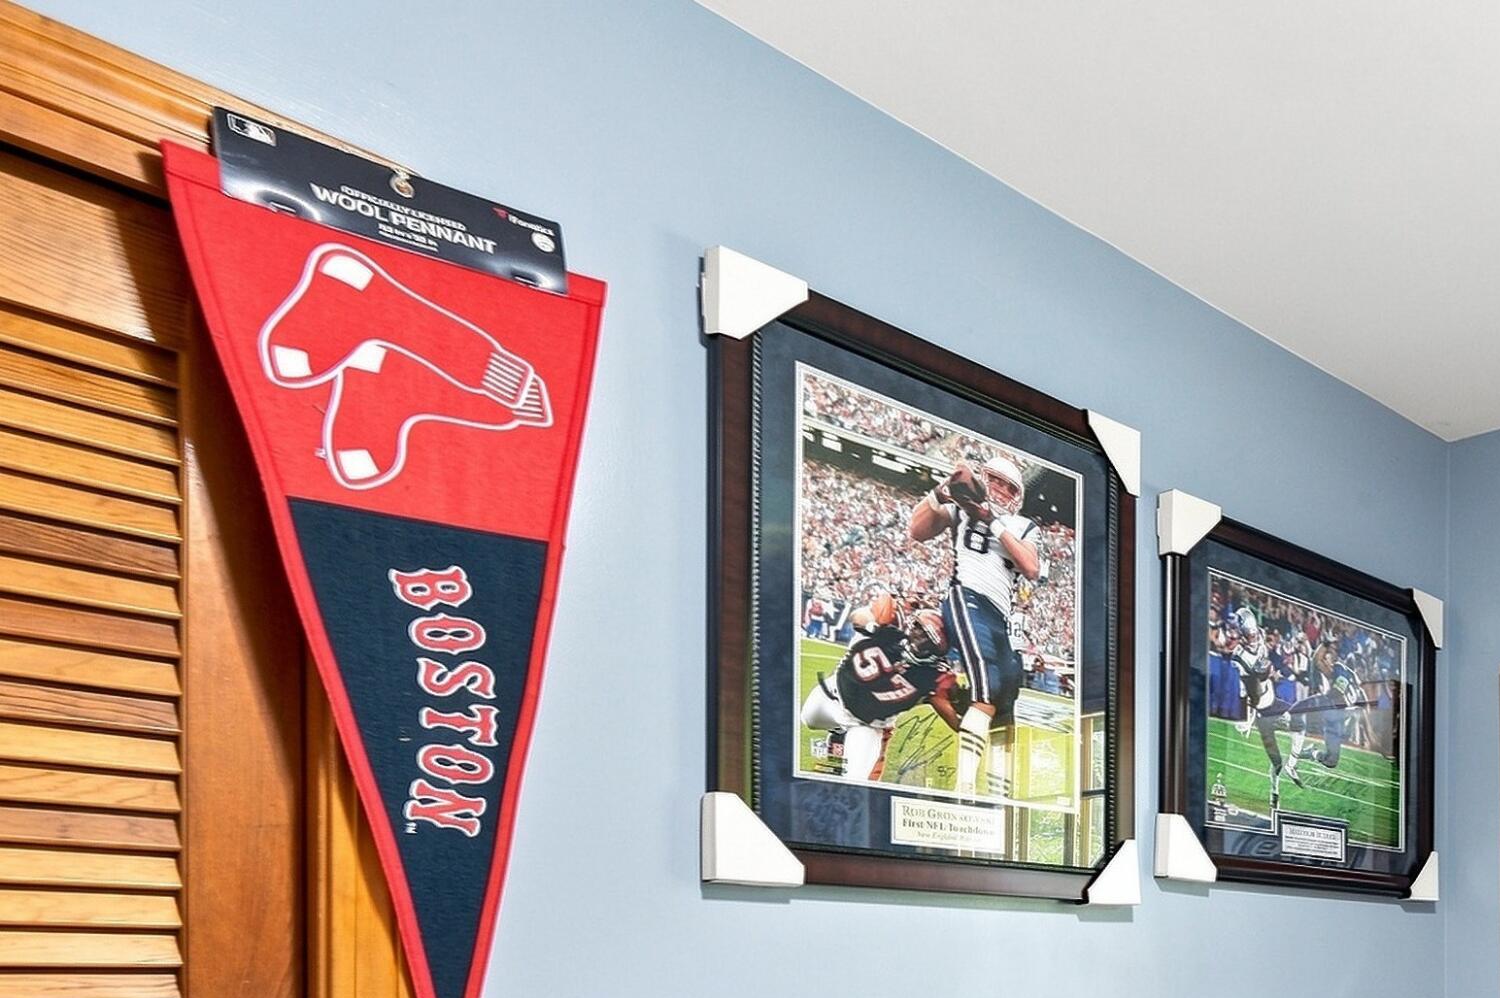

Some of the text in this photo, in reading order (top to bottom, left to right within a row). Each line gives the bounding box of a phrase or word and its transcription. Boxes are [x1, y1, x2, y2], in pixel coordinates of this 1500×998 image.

[310, 183, 388, 223] WOOL
[390, 211, 497, 254] PENNANT
[388, 565, 499, 837] BOSTON
